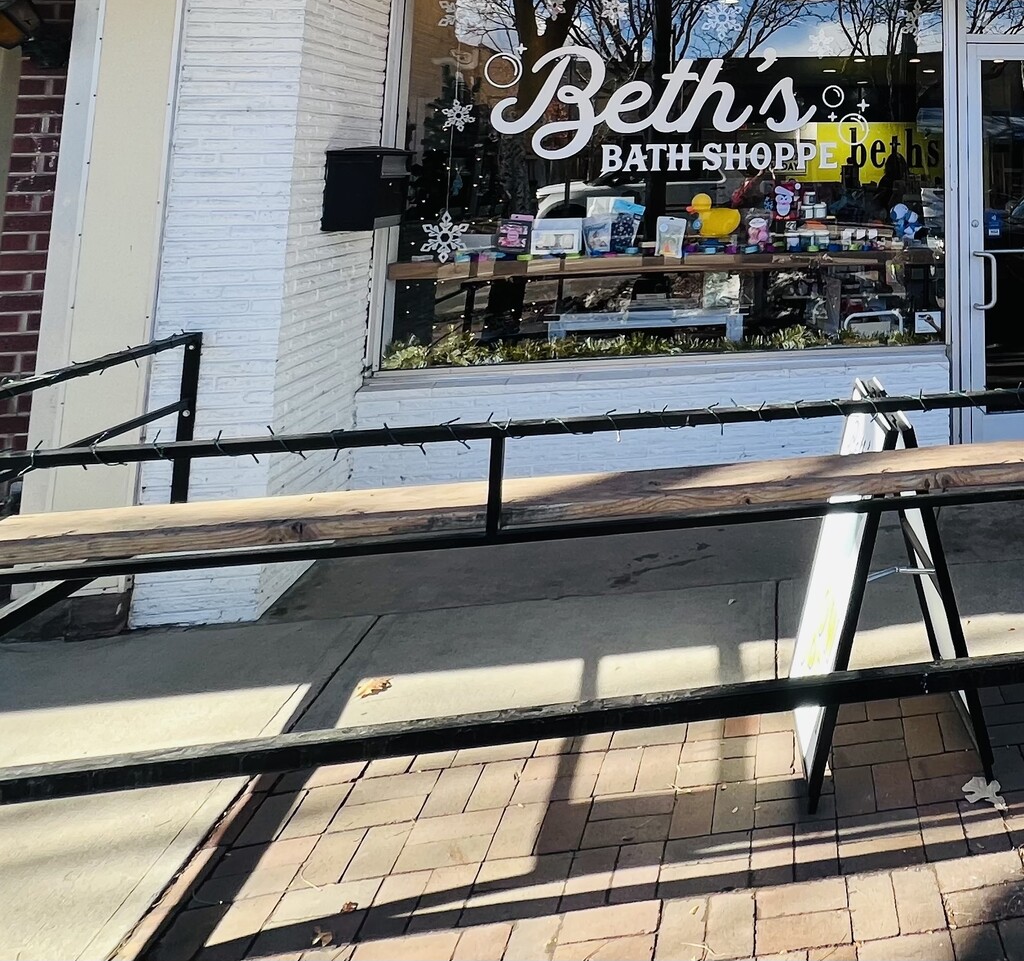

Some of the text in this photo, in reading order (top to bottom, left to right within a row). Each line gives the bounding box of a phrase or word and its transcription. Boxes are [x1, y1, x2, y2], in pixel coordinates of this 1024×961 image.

[490, 45, 817, 160] Beth's
[600, 142, 838, 174] BATH SHOPPE
[849, 126, 940, 169] beths
